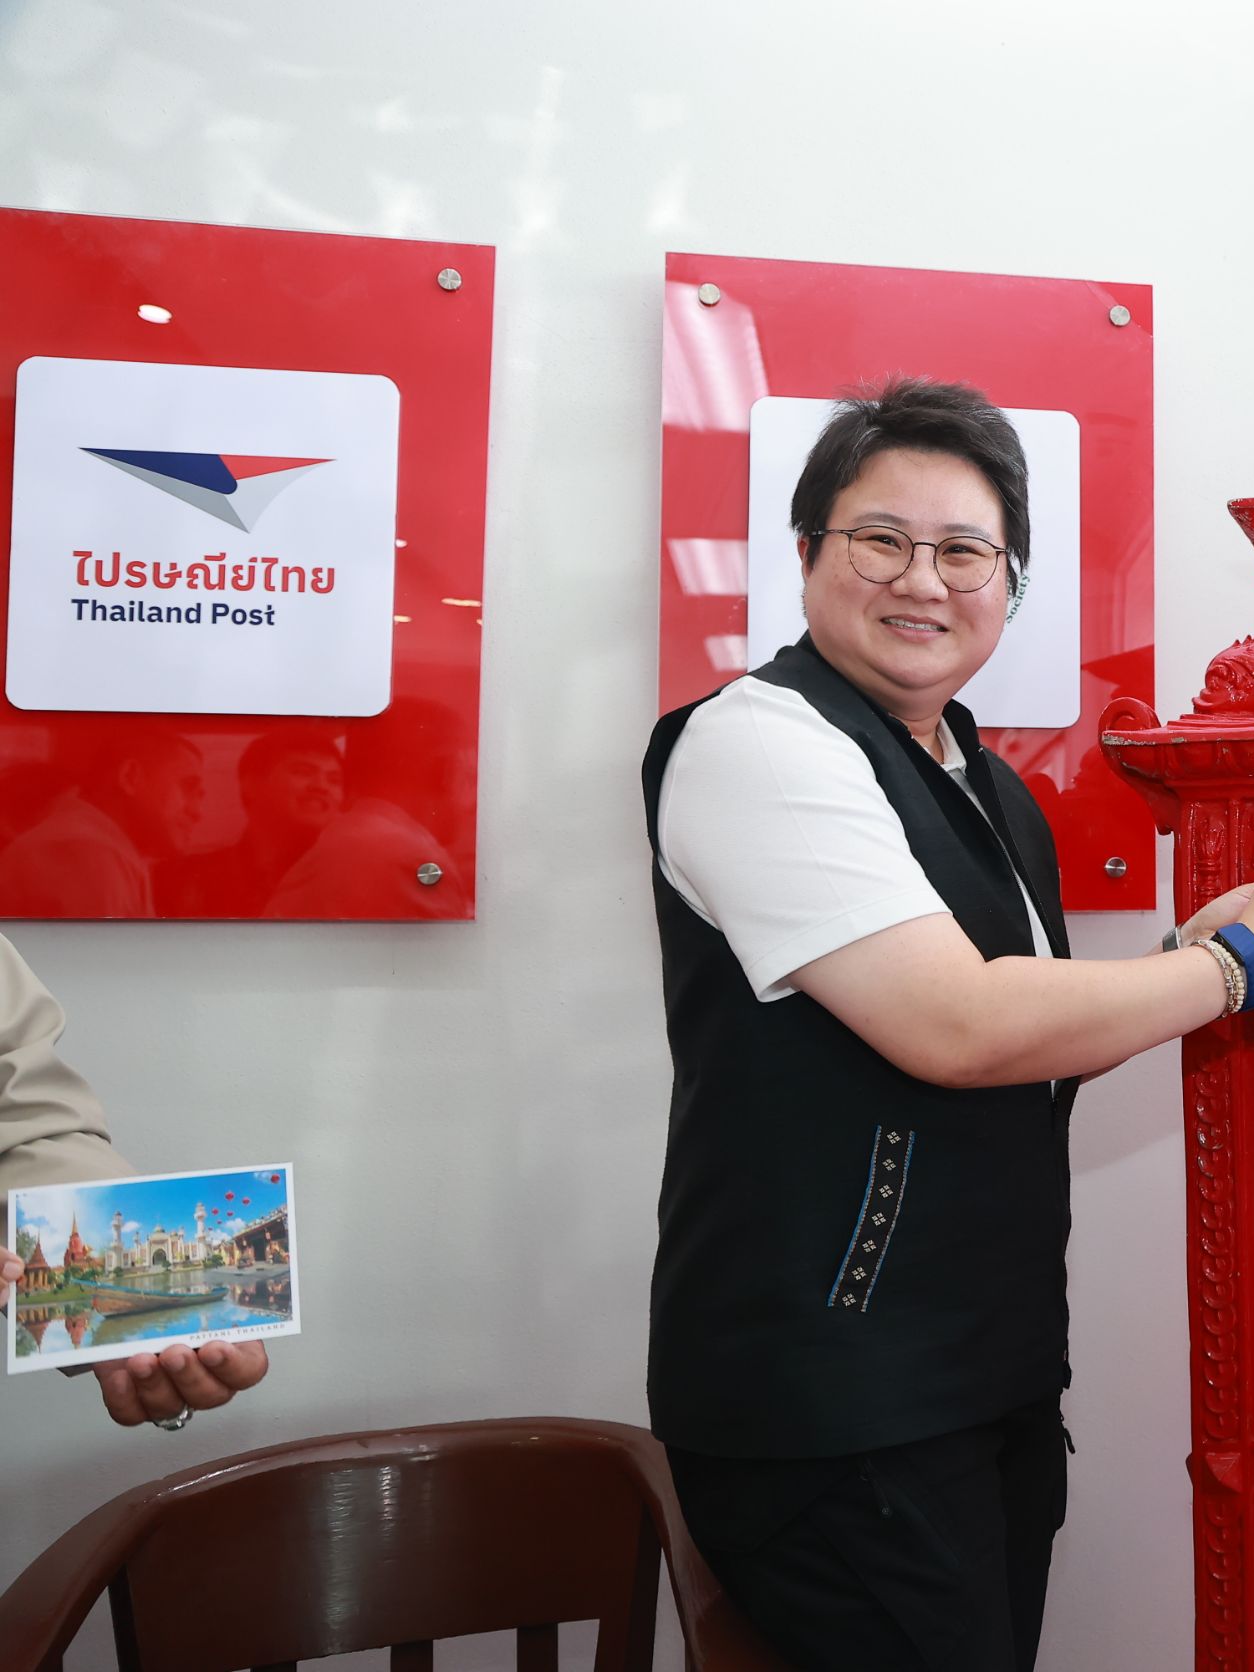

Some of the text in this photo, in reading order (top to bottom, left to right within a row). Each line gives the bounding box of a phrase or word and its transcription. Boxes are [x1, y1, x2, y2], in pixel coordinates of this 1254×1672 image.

[73, 550, 336, 595] ไปรษณีย์ไทย
[71, 598, 276, 626] Thailand Post
[1006, 574, 1030, 623] Society
